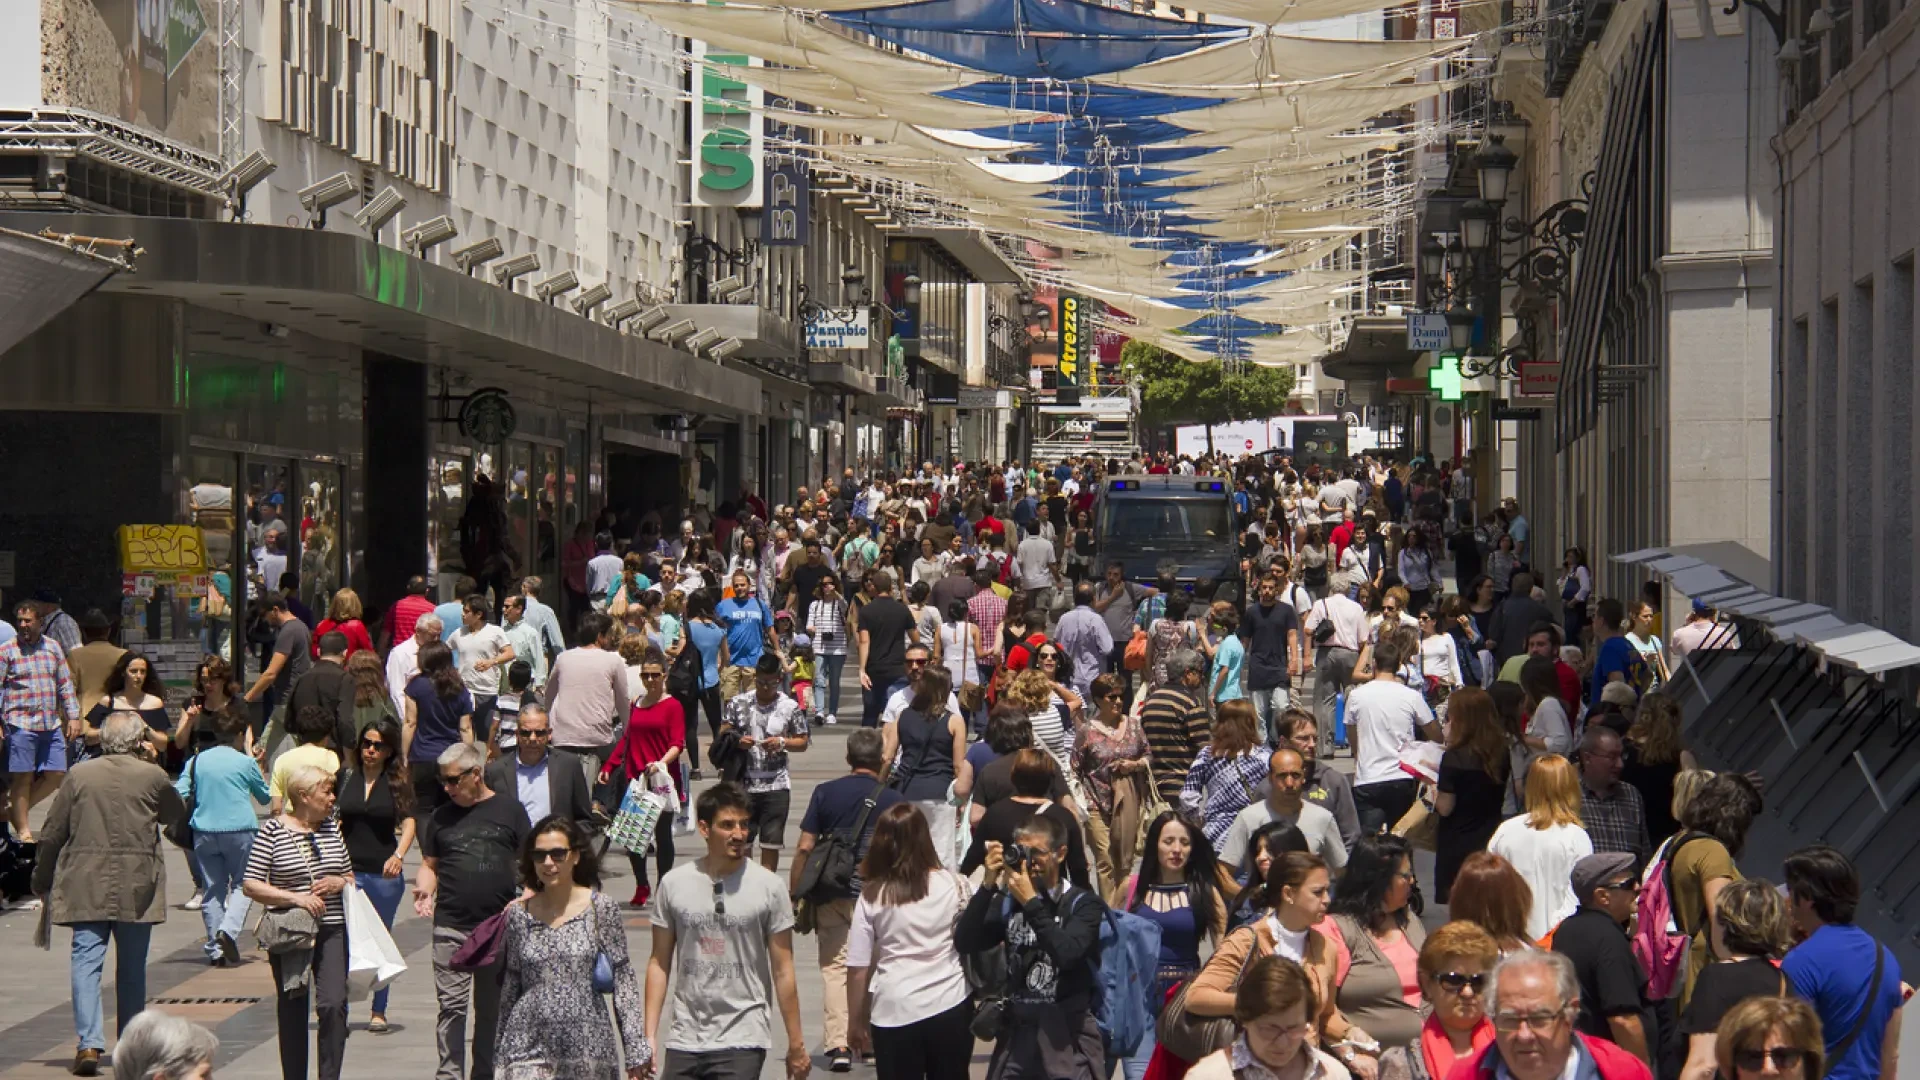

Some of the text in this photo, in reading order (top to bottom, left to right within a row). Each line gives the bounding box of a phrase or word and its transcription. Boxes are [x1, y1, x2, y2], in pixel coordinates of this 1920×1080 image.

[1413, 316, 1426, 326] El
[807, 323, 867, 336] Danubio
[807, 336, 839, 347] Azul
[1060, 298, 1077, 385] Atrezzo
[1413, 338, 1441, 348] Azul
